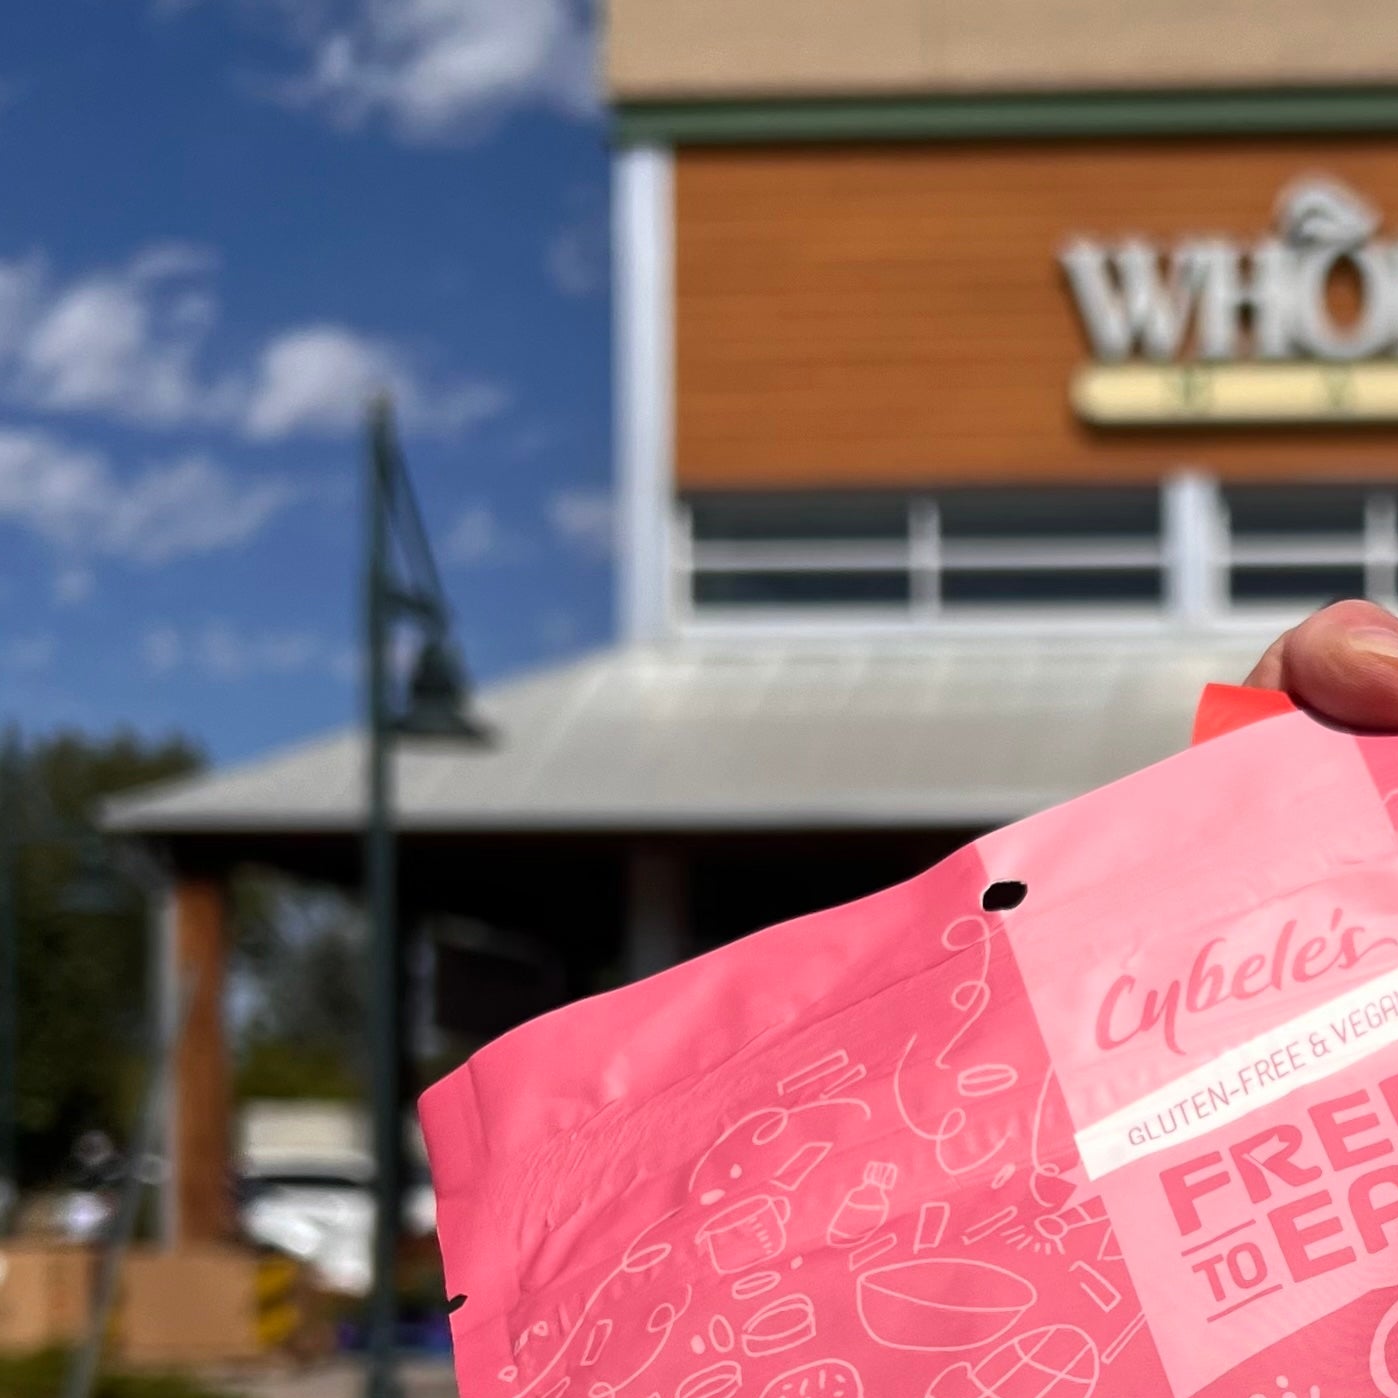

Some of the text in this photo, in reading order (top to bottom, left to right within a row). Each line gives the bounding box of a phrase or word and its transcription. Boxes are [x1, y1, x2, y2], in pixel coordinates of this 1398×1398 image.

[1095, 907, 1398, 1056] Cybele's
[1127, 1047, 1307, 1147] GLUTEN-FREE
[1310, 1031, 1332, 1057] &
[1192, 1241, 1268, 1302] TO
